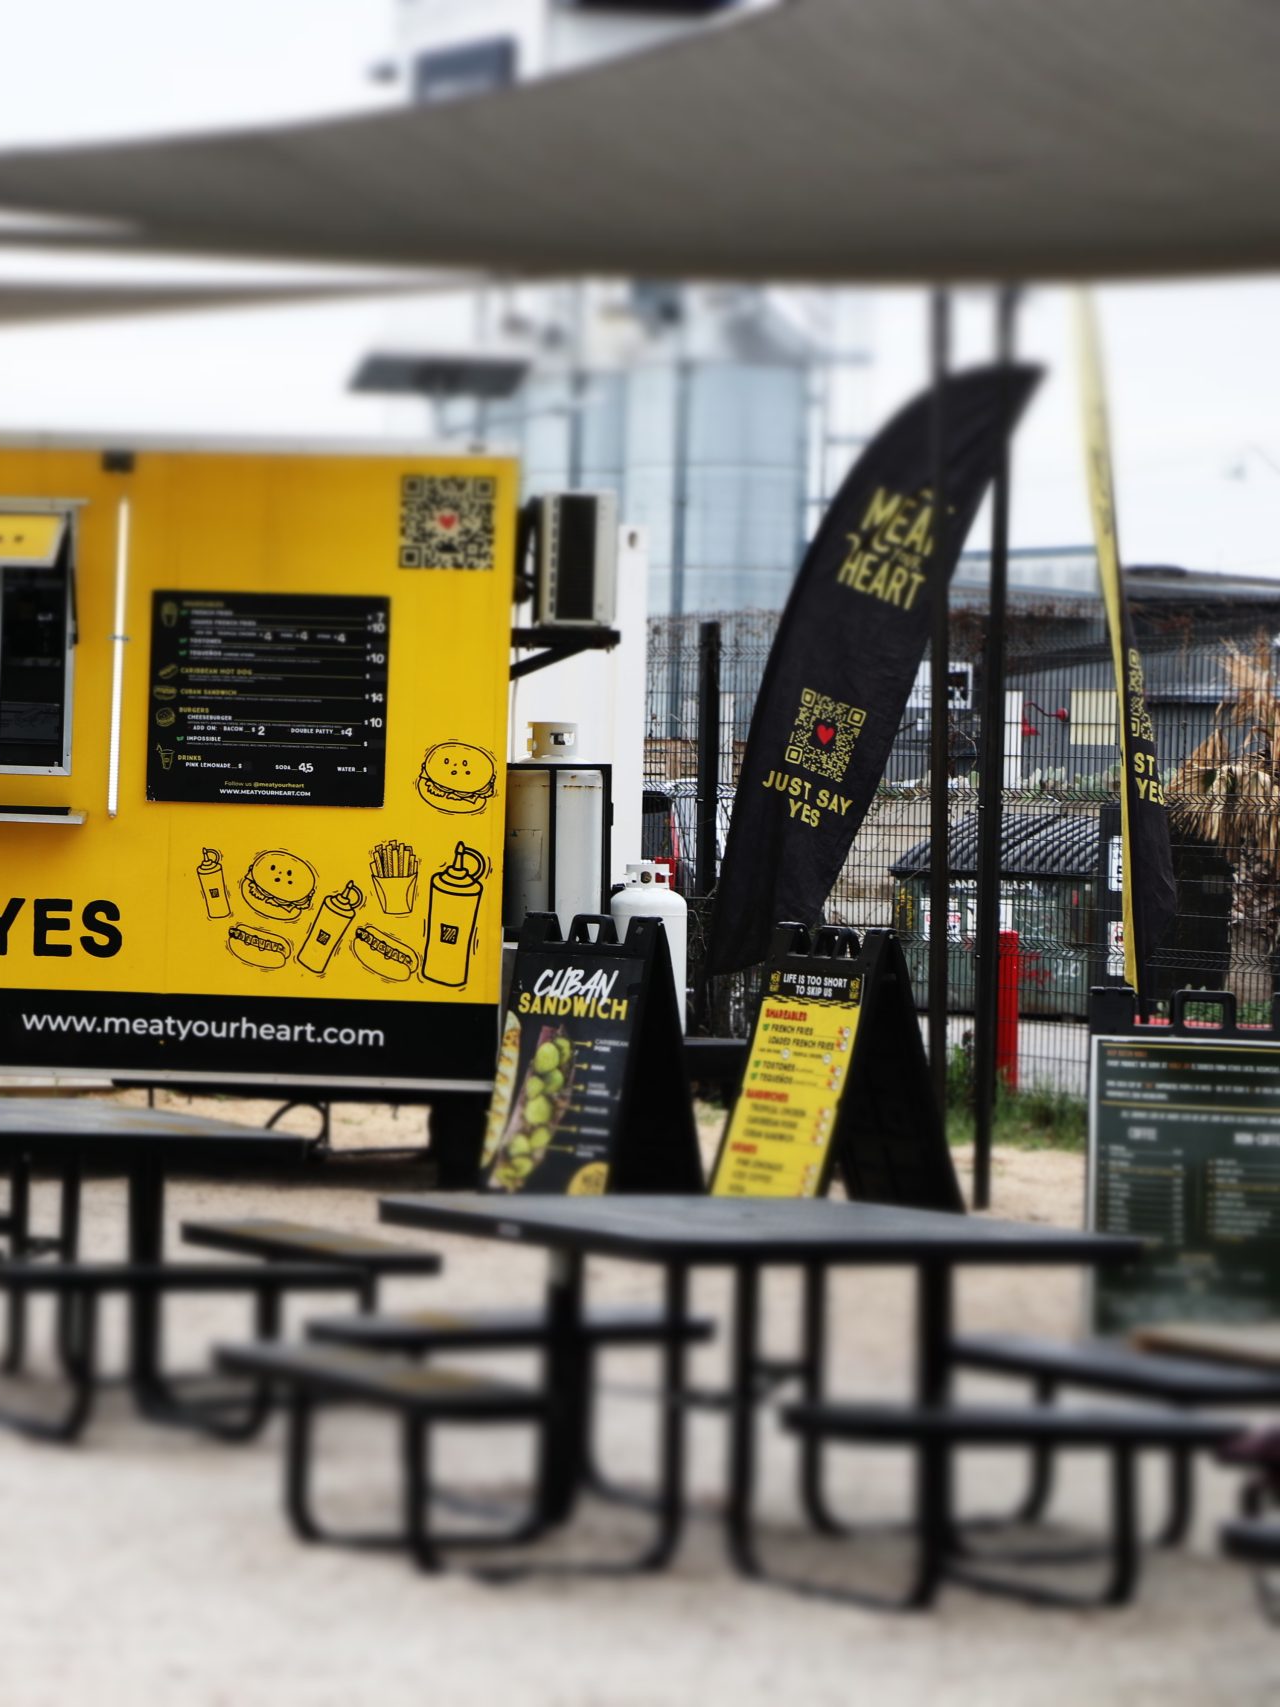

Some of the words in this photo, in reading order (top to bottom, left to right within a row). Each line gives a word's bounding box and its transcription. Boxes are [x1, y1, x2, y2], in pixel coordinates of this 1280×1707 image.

[837, 532, 926, 611] HEART
[219, 788, 311, 797] WWW.MEATYOURHEART.COM
[253, 781, 305, 789] @meatyourheart
[762, 770, 812, 800] JUST
[816, 788, 853, 817] SAY
[1135, 777, 1164, 805] YES
[788, 798, 822, 828] YES
[533, 966, 619, 1006] CUBAN
[783, 973, 797, 984] LIFE
[798, 974, 806, 984] IS
[807, 975, 821, 986] TOO
[823, 977, 848, 988] SHORT
[795, 985, 805, 995] TO
[806, 986, 823, 997] SKIP
[823, 988, 833, 998] US
[518, 992, 628, 1020] SANDWICH
[21, 1013, 385, 1047] www.meatyourheart.com
